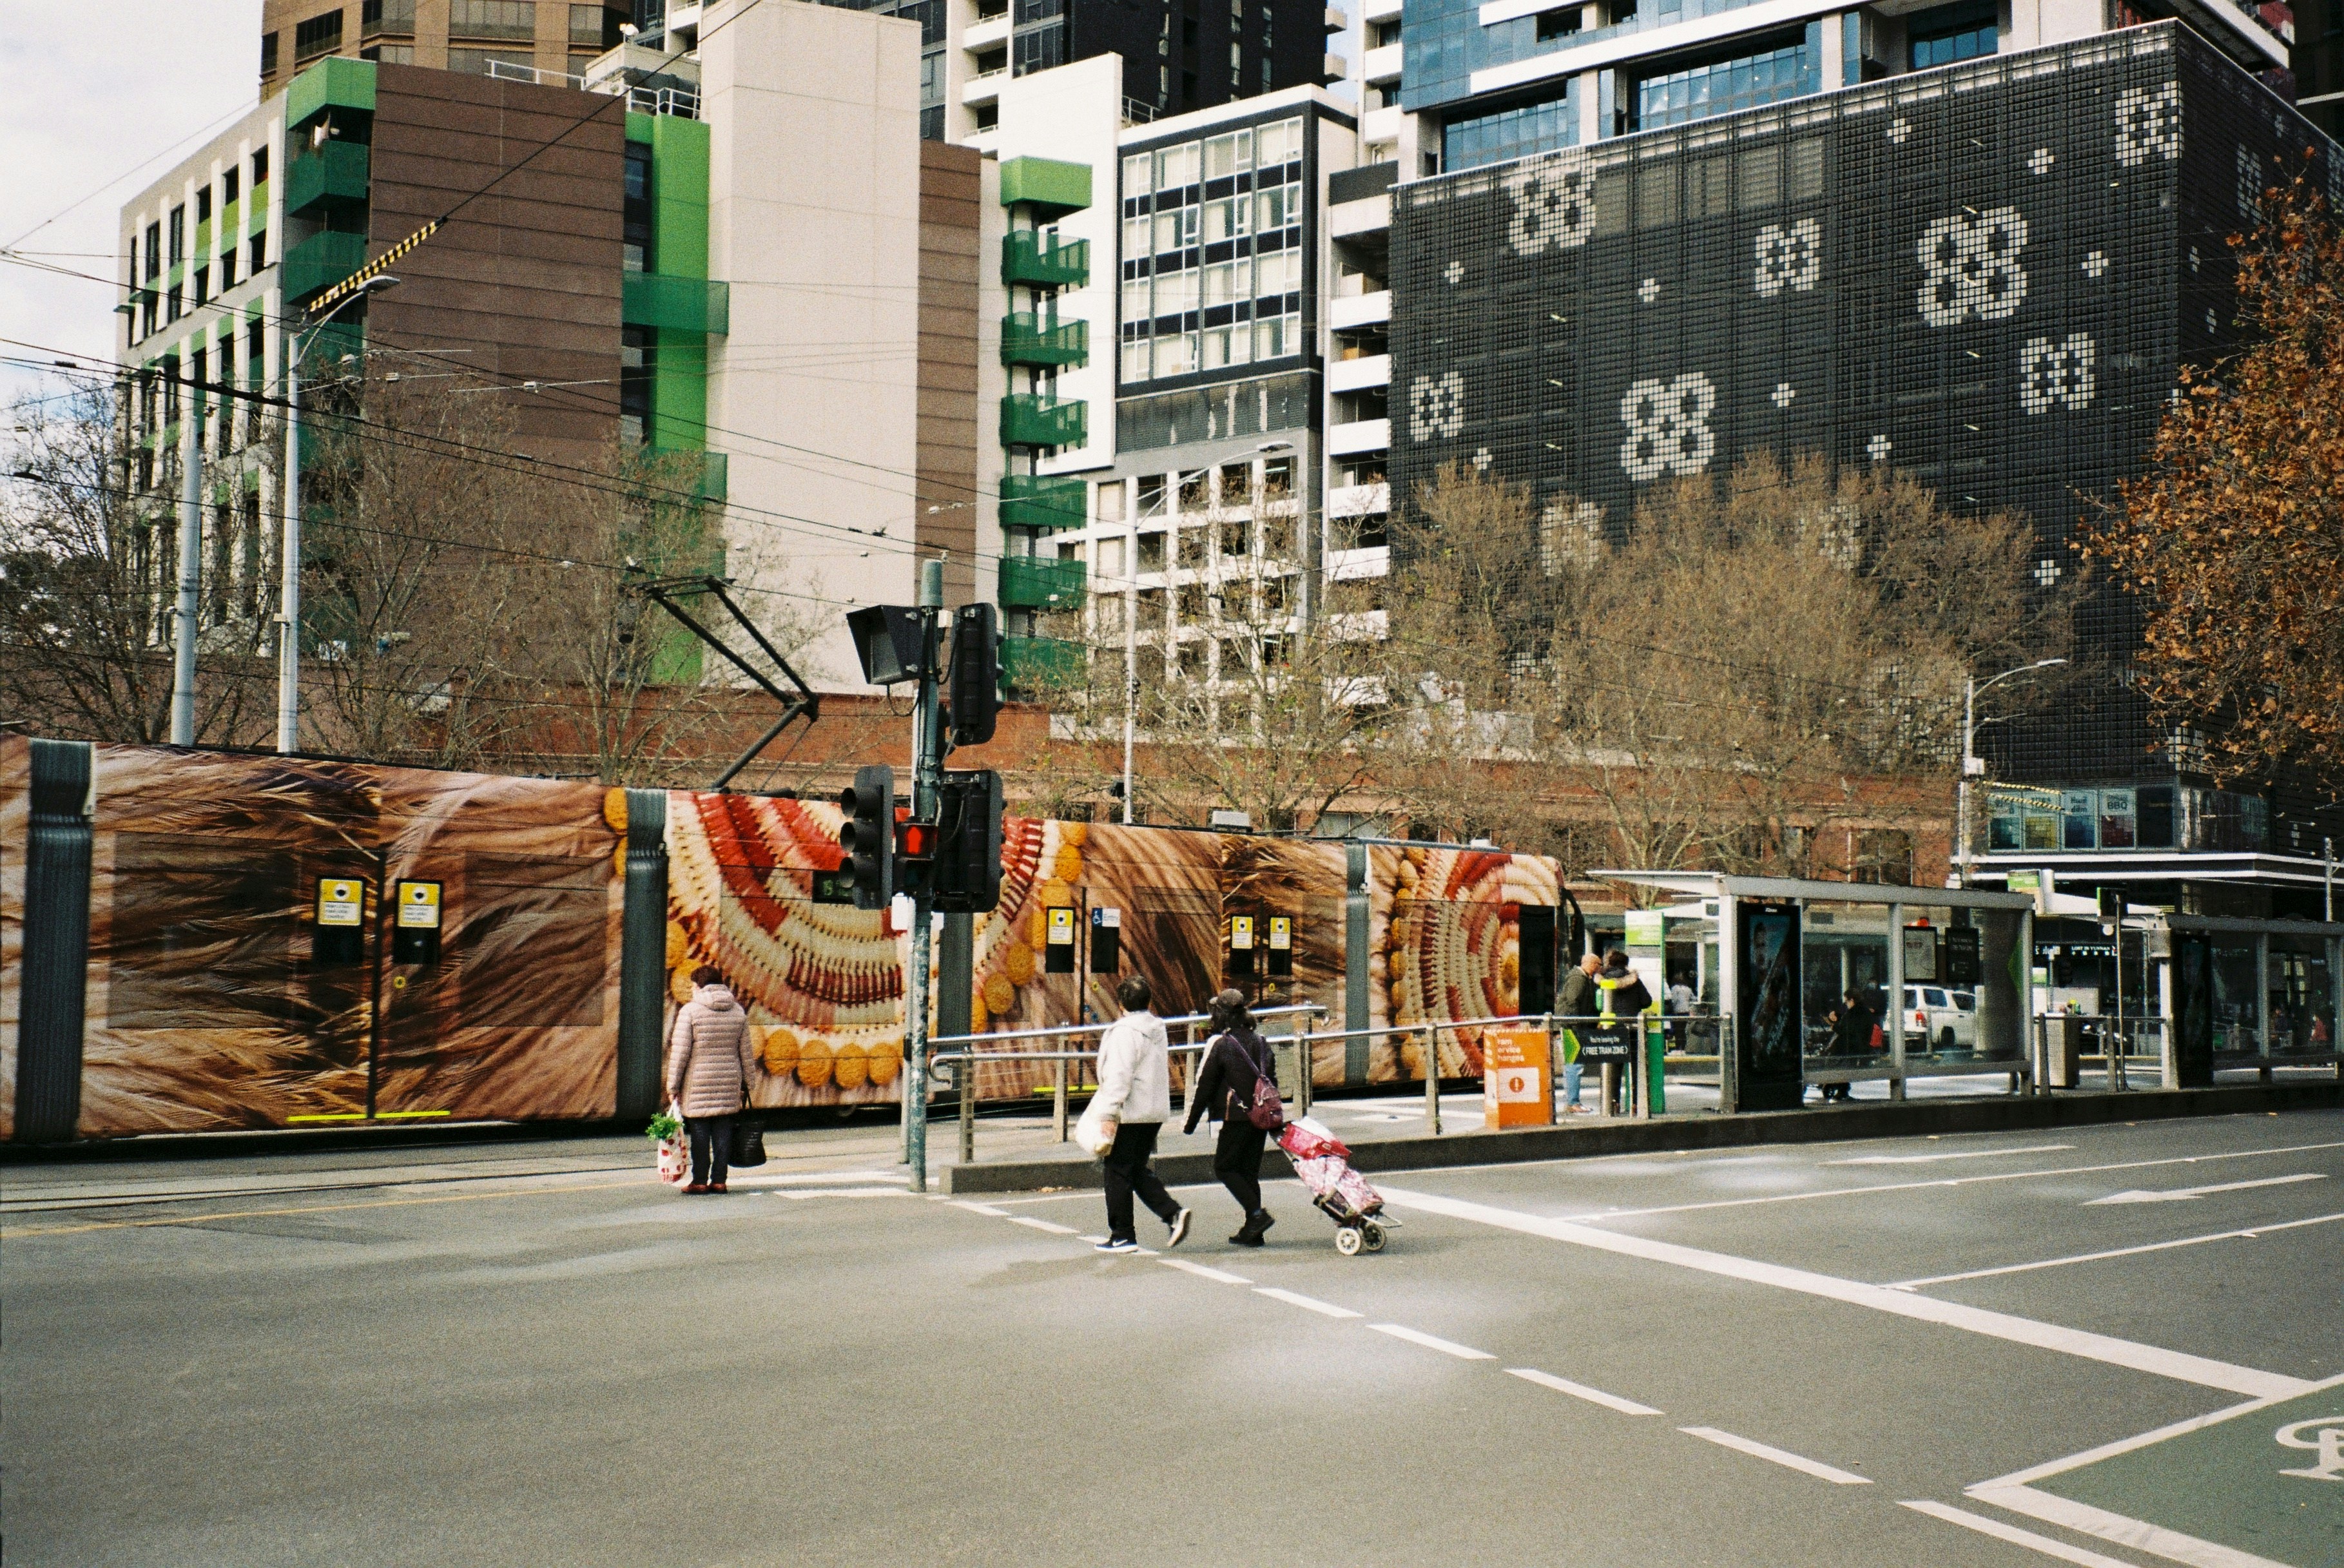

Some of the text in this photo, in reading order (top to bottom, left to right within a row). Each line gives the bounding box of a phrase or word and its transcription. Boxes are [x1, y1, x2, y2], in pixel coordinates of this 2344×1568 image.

[2107, 802, 2127, 810] BBQ
[1585, 1046, 1625, 1055] FREE TRAM ZONE
